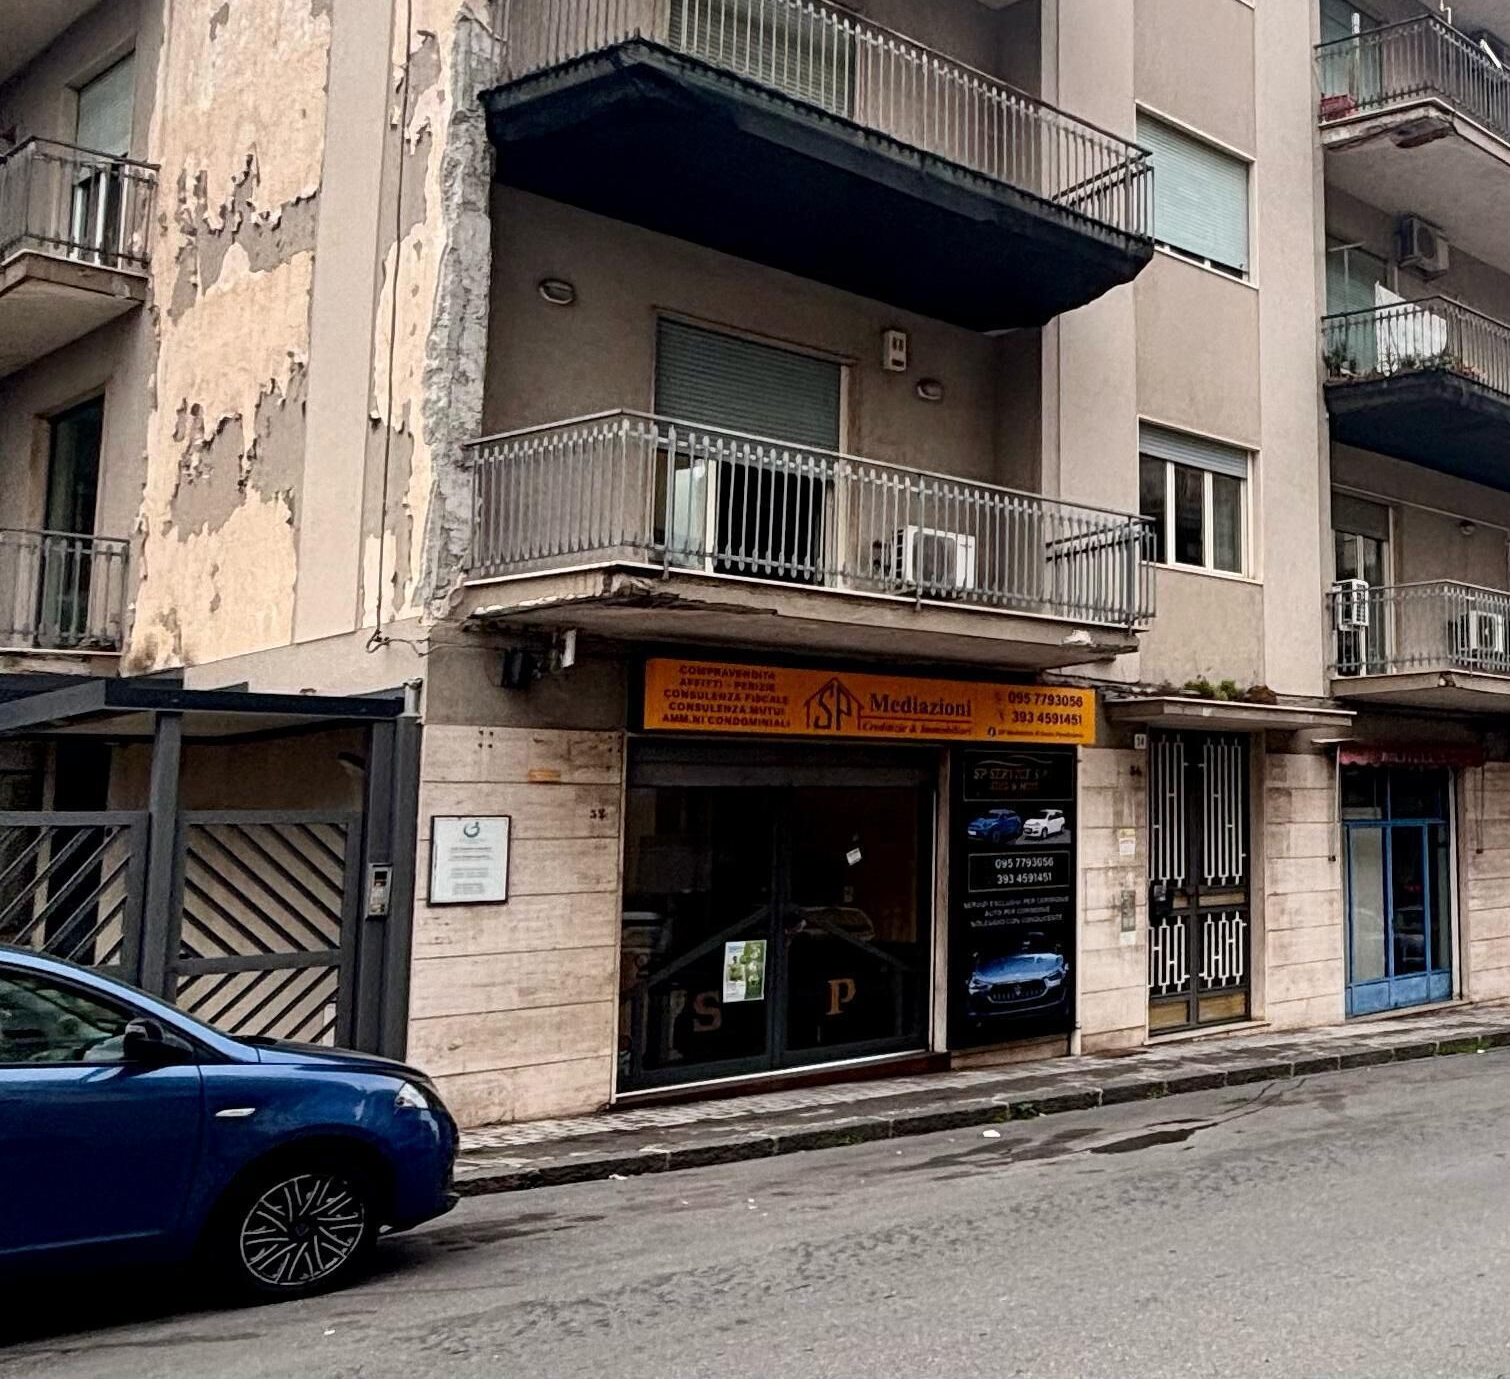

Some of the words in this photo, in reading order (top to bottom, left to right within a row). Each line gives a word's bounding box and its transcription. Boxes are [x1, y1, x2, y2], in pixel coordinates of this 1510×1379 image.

[680, 665, 776, 680] COMPRAVENDITA
[663, 689, 741, 701] CONSULENZA
[1008, 691, 1032, 705] 095
[1034, 693, 1084, 708] 7793056
[668, 701, 747, 714] CONSULENZA
[749, 706, 785, 716] MUTUI
[869, 693, 972, 717] Mediazioni
[707, 716, 791, 728] CONDOMINIALI
[1012, 711, 1035, 725] 393
[1037, 712, 1082, 726] 4591451
[994, 859, 1013, 869] 095
[1015, 857, 1054, 868] 7793056
[997, 873, 1015, 884] 393
[1016, 872, 1052, 883] 4591451
[826, 978, 856, 1016] P
